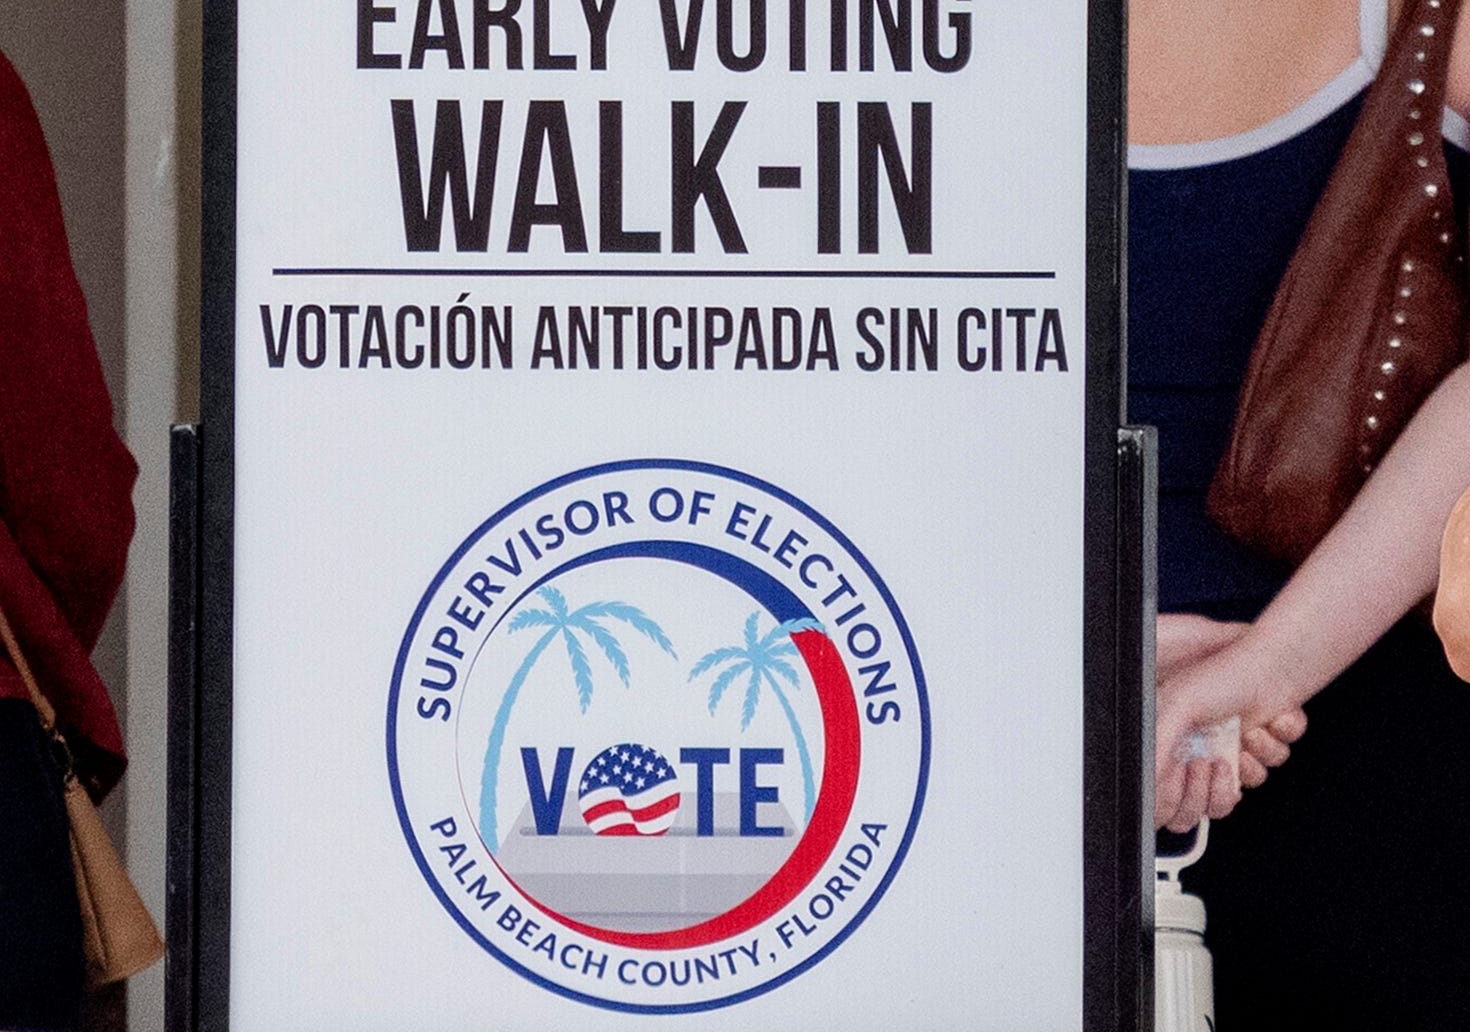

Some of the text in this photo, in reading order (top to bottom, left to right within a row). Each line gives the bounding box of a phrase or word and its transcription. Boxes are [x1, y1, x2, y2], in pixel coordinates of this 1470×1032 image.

[390, 99, 933, 255] WALK-IN
[259, 292, 1069, 372] VOTACIÓN ANTICIPADA SIN CITA
[416, 486, 901, 726] SUPERVISOR OF ELECTIONS
[429, 816, 888, 988] PALM BEACH COUNTY, FLORIDA
